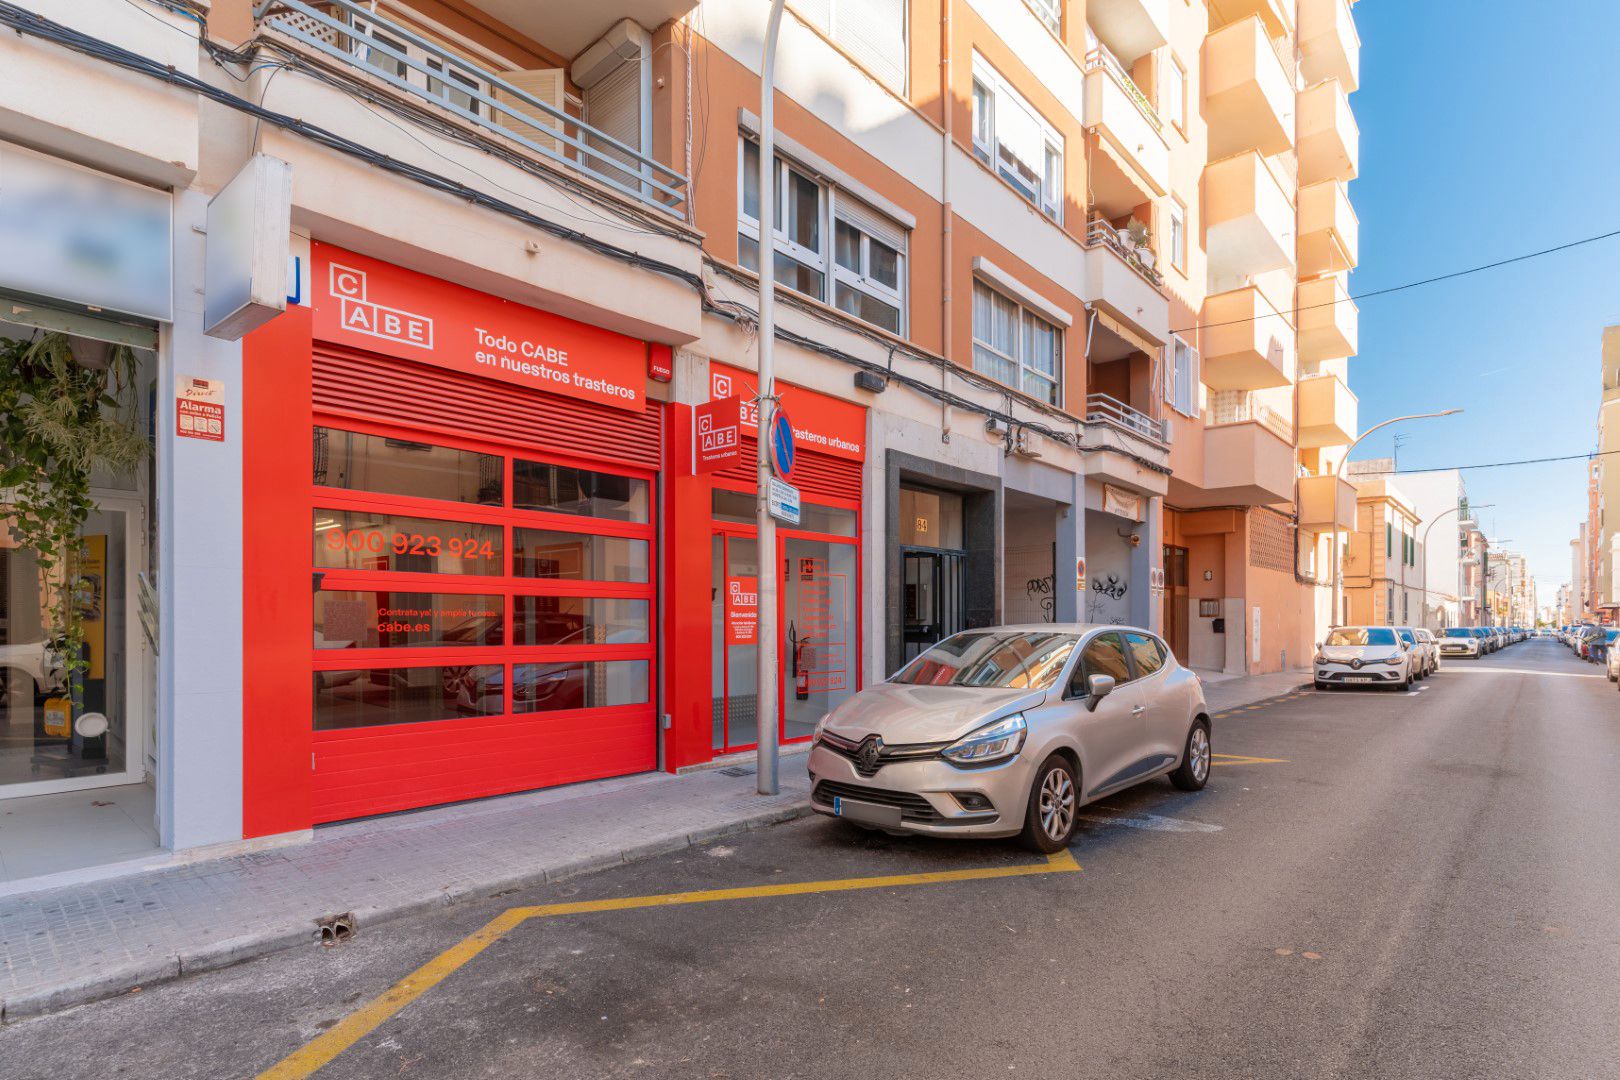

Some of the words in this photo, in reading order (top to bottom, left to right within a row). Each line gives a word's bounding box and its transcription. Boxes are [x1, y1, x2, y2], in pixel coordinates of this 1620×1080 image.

[474, 327, 518, 353] Todo
[521, 341, 569, 367] CABE
[475, 350, 497, 366] en
[500, 356, 570, 384] nuestros
[573, 372, 636, 400] trasteros
[180, 400, 222, 415] Alarma
[828, 437, 860, 453] urbanos
[326, 528, 385, 554] 900
[391, 532, 442, 557] 923
[448, 537, 495, 560] 924
[433, 609, 439, 618] y
[377, 620, 431, 633] cabe.es
